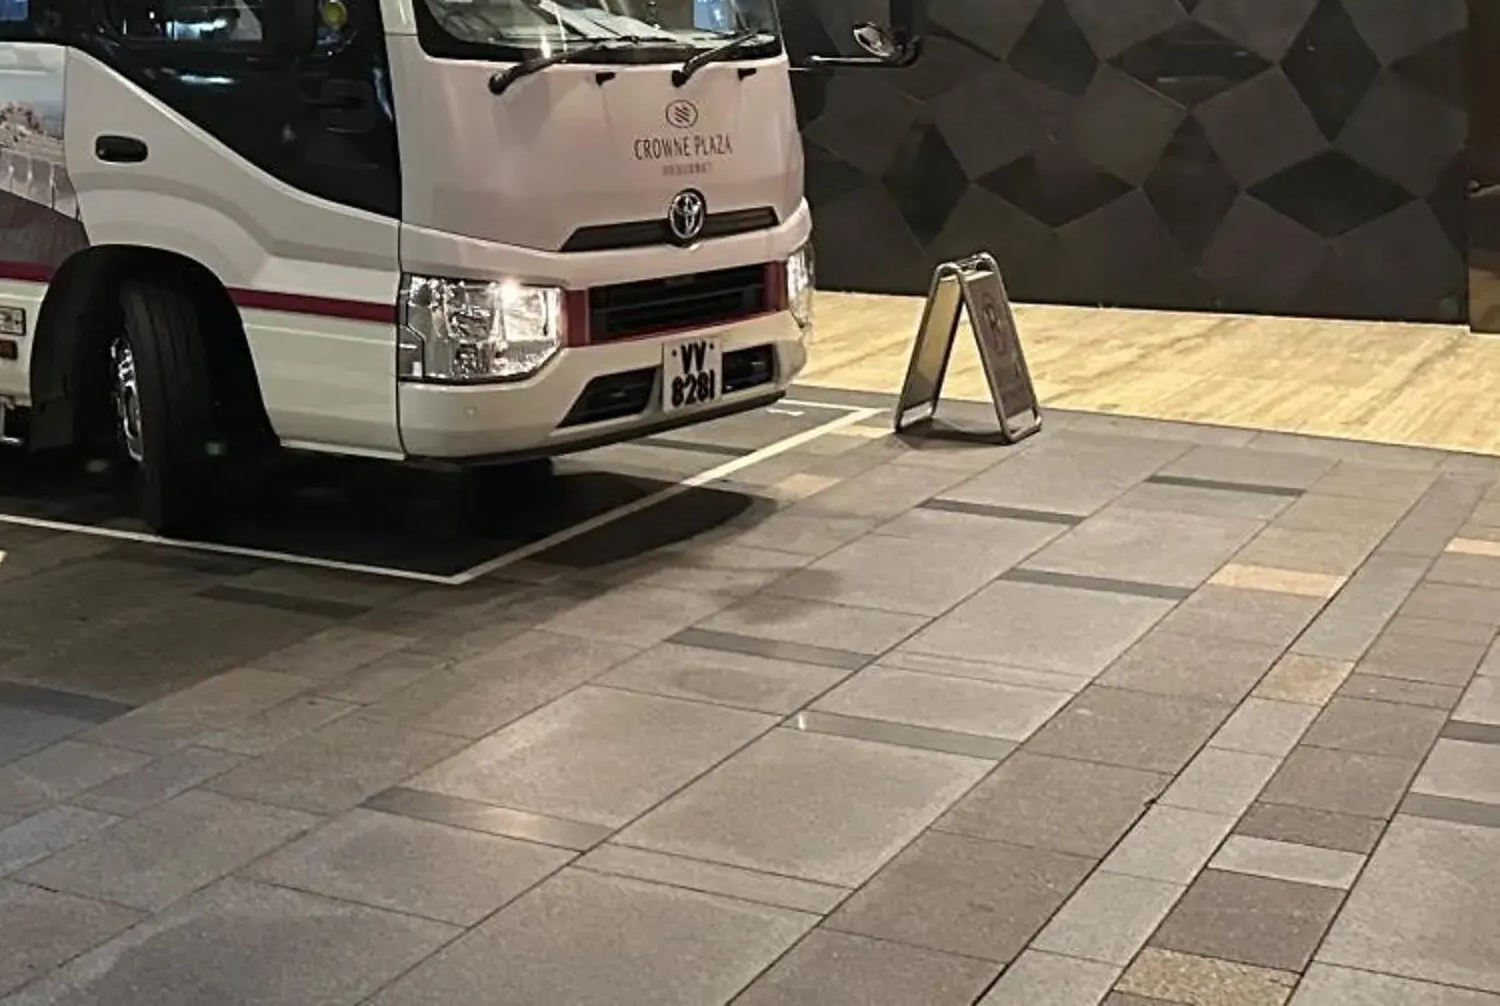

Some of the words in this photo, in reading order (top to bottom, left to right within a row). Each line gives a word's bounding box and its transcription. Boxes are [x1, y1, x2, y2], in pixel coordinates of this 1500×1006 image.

[634, 137, 692, 160] CROWNE
[695, 133, 733, 156] PLAZA
[672, 370, 715, 407] 8281
